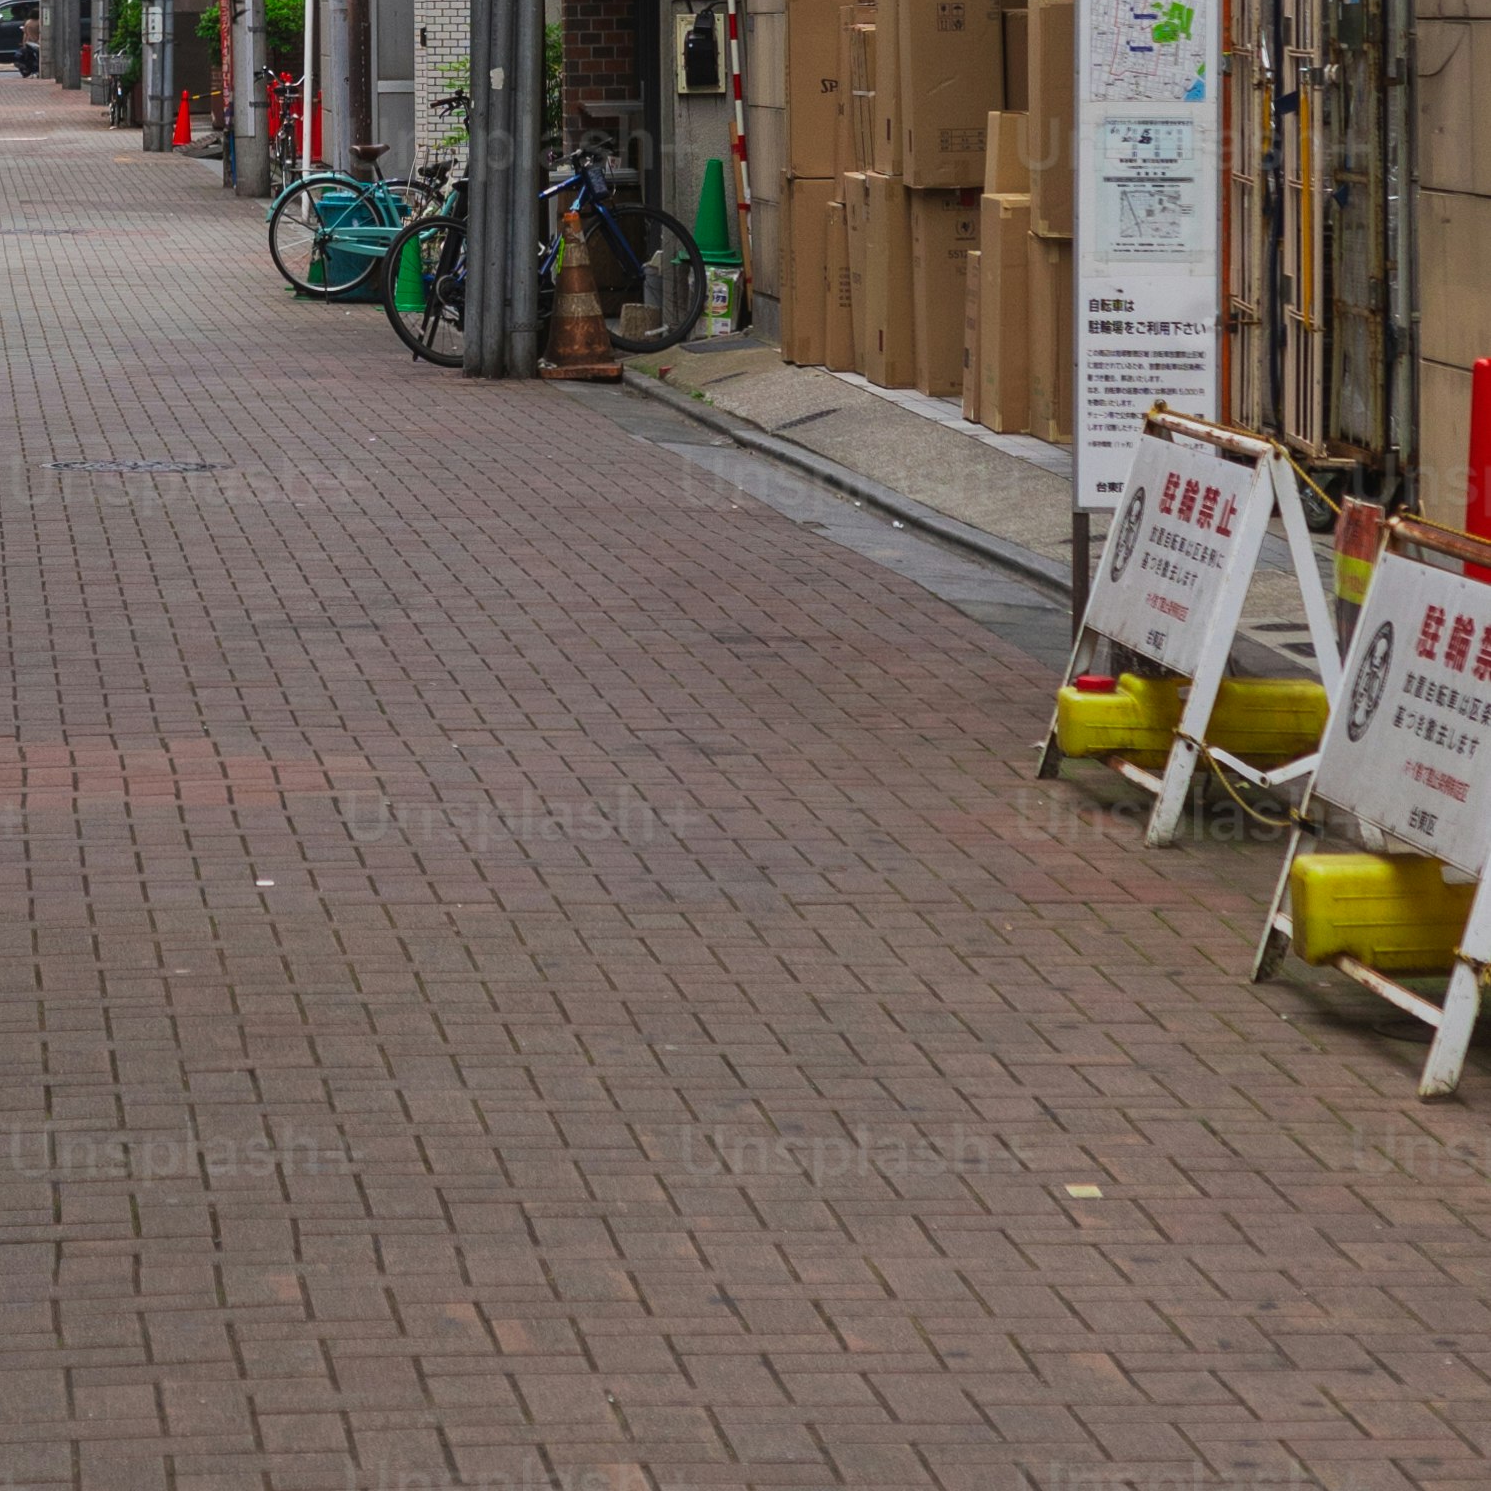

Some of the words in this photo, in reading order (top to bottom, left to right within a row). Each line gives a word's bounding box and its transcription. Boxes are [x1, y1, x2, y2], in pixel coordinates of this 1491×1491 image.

[1088, 298, 1135, 313] 自転車は
[1088, 321, 1207, 336] 駐輪場をご利用下さい
[1158, 472, 1238, 538] 駐輪禁止
[1409, 805, 1439, 838] 台東区
